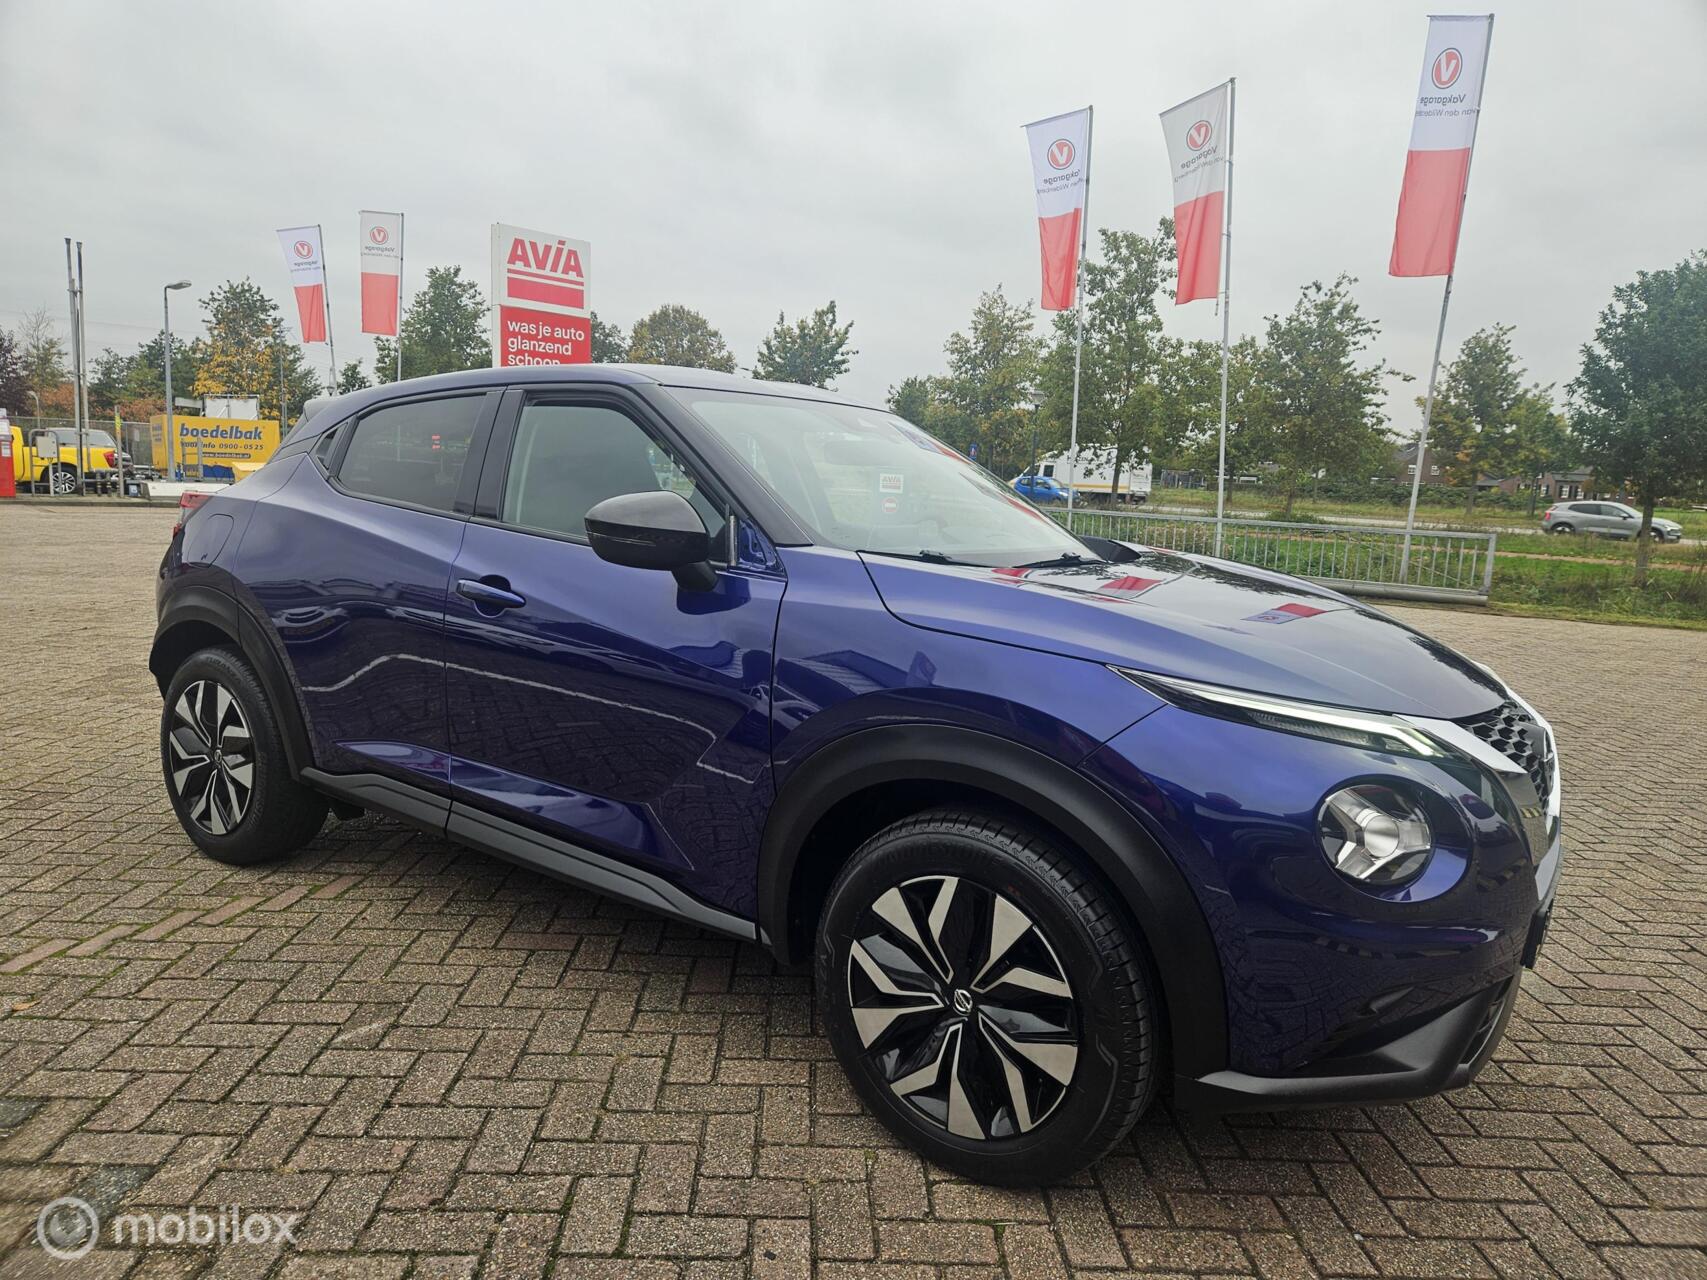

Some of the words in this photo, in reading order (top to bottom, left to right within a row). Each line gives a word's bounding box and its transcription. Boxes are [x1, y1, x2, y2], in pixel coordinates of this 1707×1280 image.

[507, 237, 584, 279] AVIA
[507, 320, 537, 334] was
[538, 322, 551, 338] je
[554, 327, 585, 341] auto
[507, 335, 572, 355] glanzend
[180, 423, 263, 440] boedelbak
[219, 442, 239, 450] 0900
